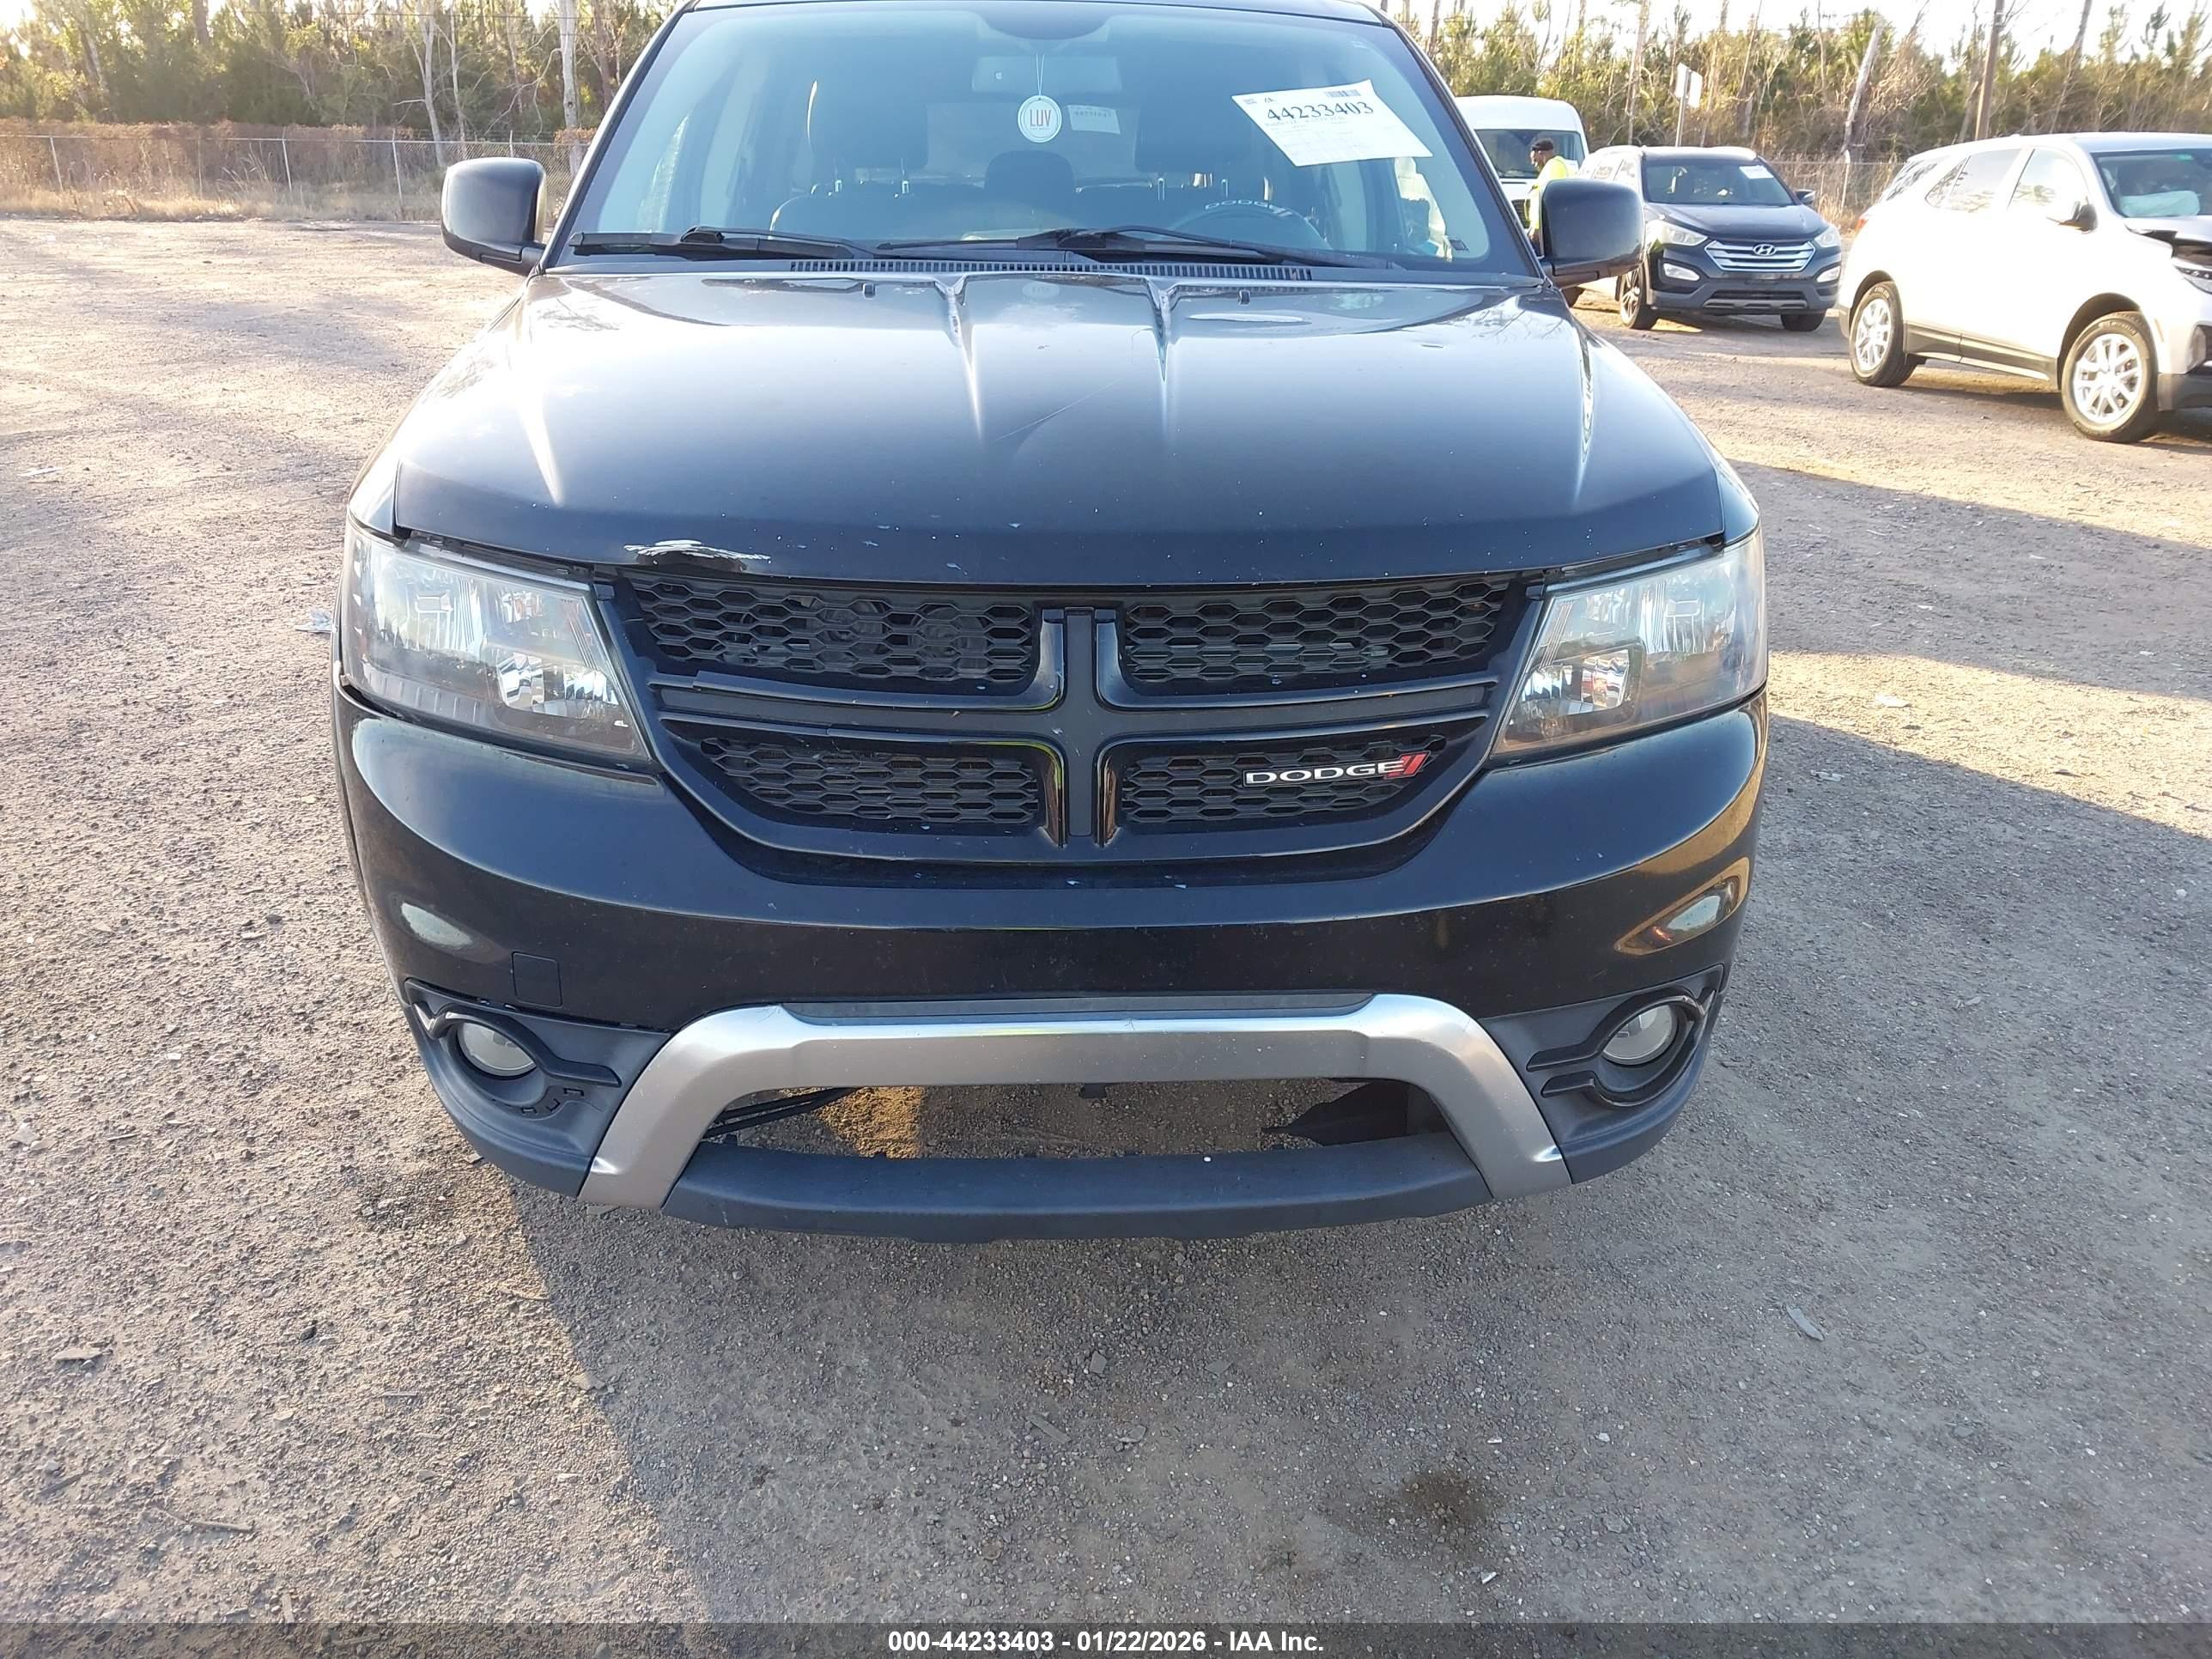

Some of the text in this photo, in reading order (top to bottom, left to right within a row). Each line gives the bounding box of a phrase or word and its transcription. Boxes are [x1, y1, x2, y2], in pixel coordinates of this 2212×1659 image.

[1030, 109, 1052, 127] LUV
[1267, 101, 1374, 121] 44233403
[1246, 760, 1405, 784] DODGE
